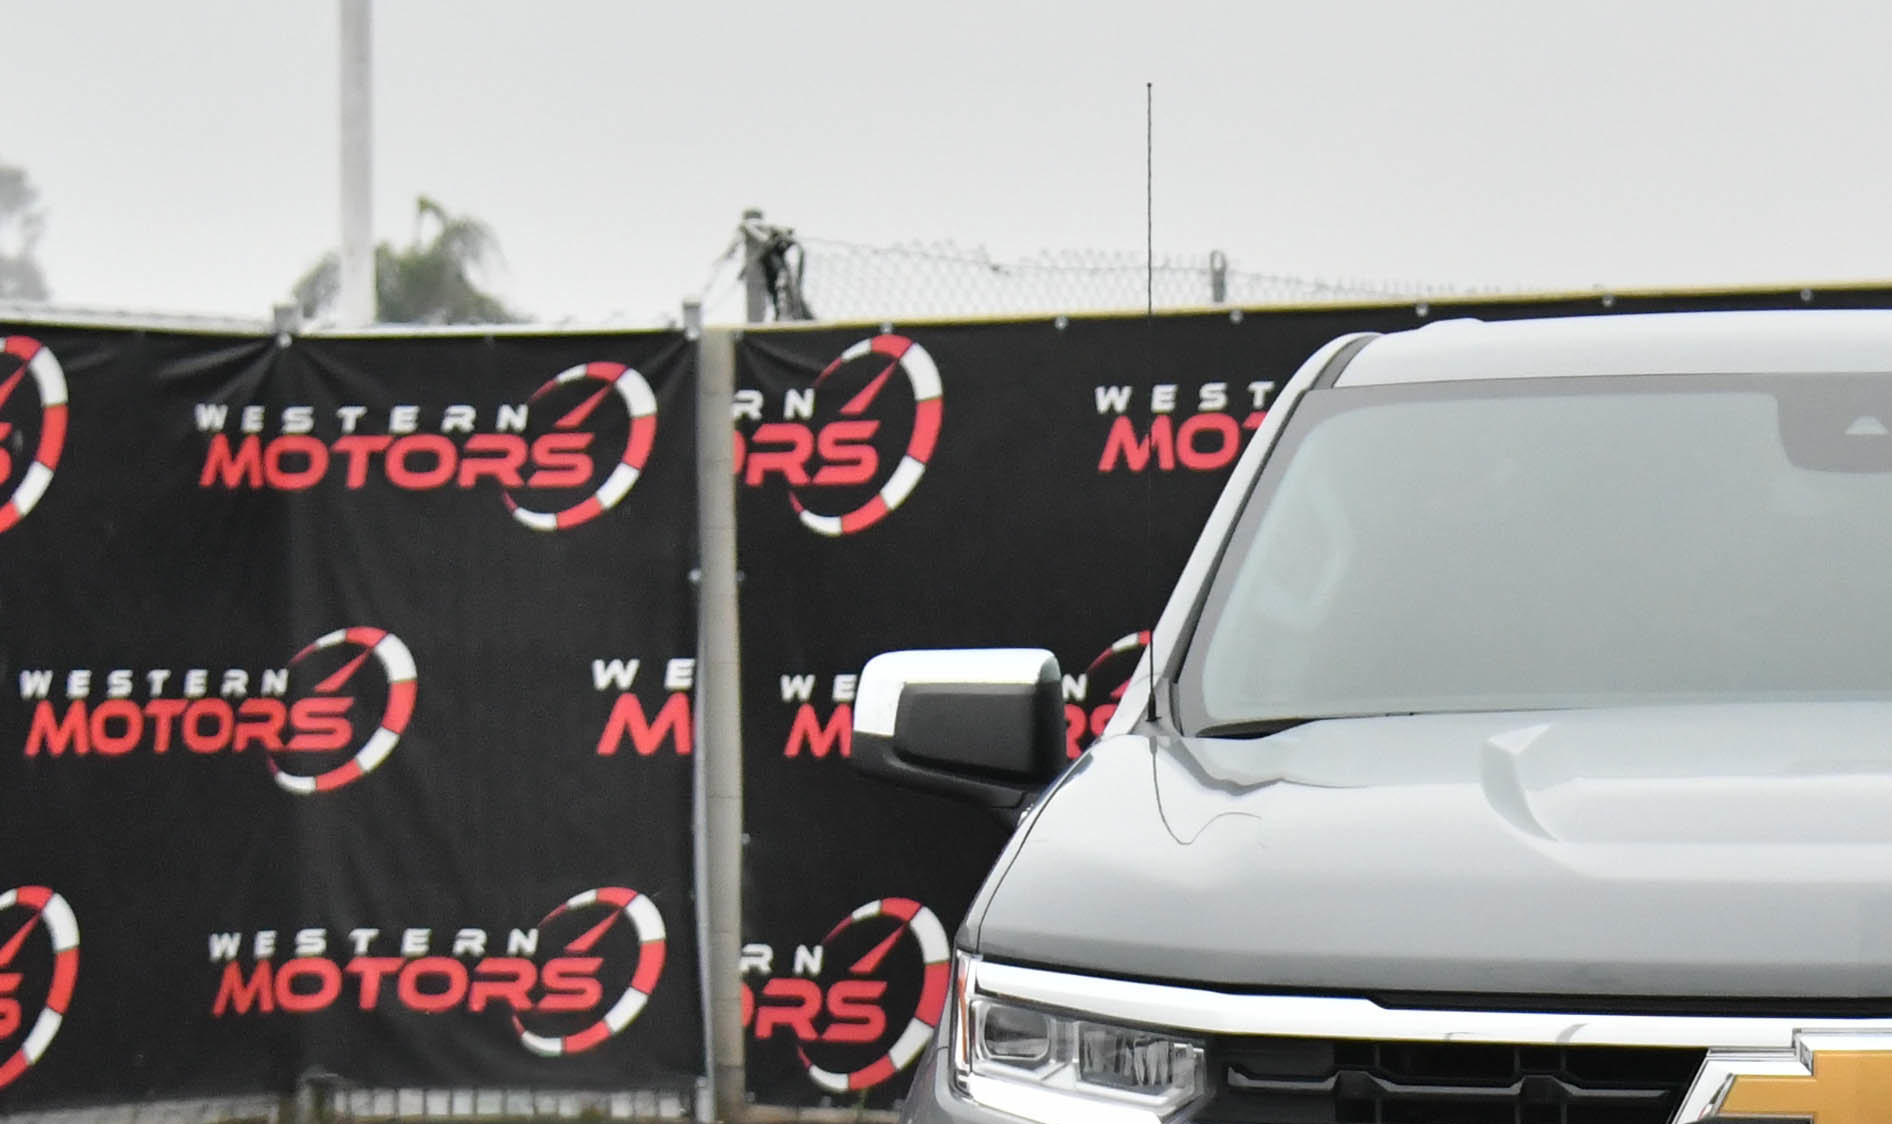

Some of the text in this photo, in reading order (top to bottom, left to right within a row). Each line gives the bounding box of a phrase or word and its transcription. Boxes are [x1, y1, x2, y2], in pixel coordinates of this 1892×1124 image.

[195, 403, 529, 433] WESTERN
[200, 433, 594, 491] MOTORS
[20, 668, 289, 698] WESTERN
[25, 697, 354, 757] MOTORS
[209, 928, 539, 960] WESTERN
[213, 956, 604, 1016] MOTORS
